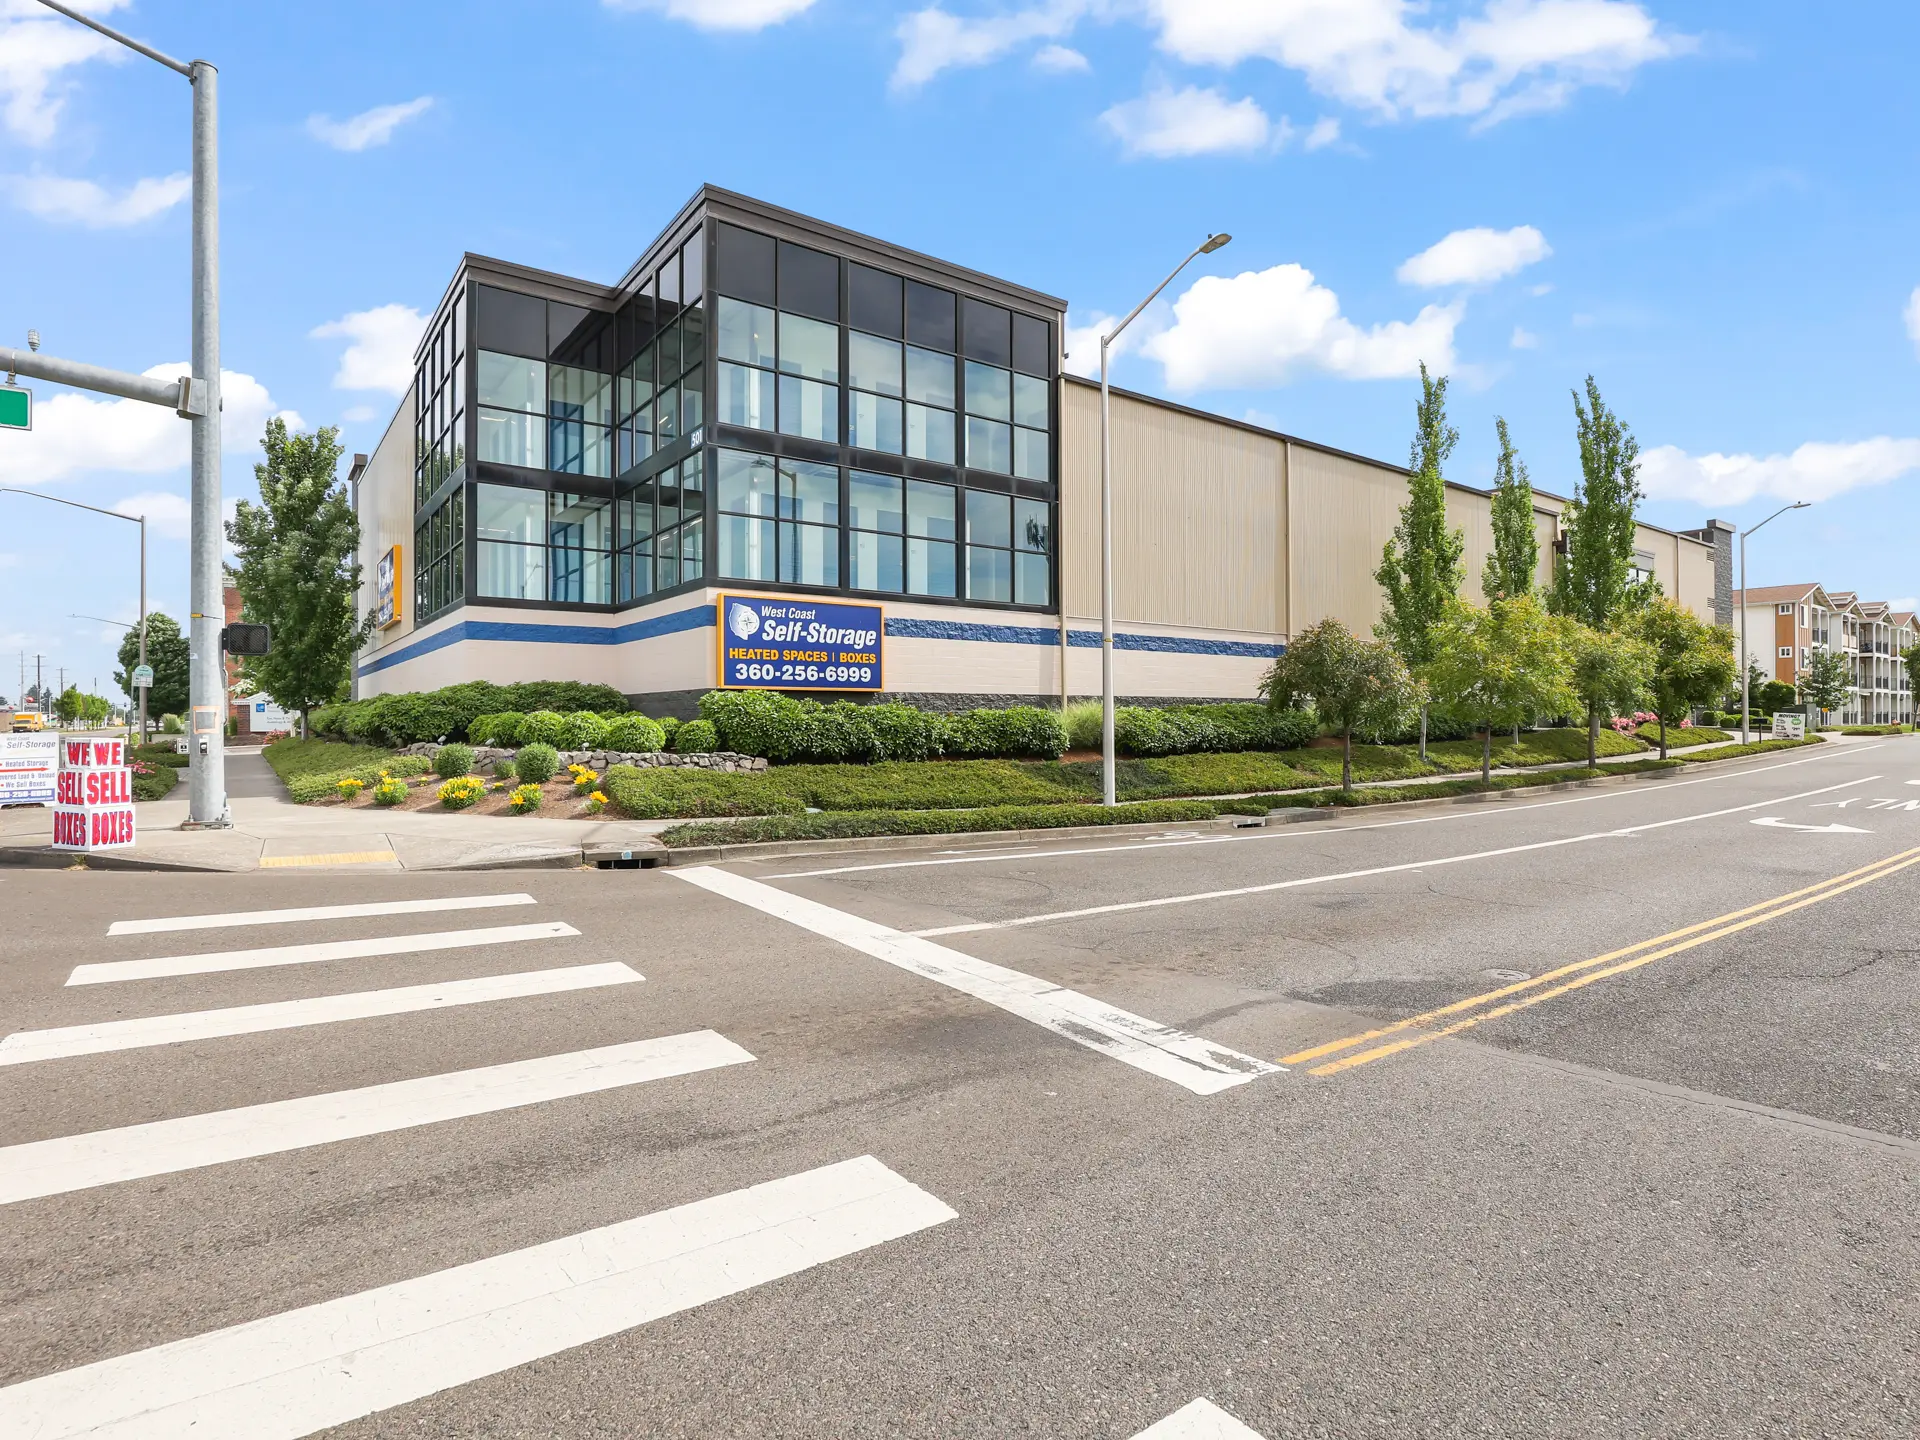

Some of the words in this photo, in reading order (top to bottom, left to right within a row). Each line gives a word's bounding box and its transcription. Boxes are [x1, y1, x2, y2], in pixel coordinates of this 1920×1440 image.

[692, 430, 702, 447] 501
[761, 605, 786, 618] West
[788, 607, 816, 620] Coast
[761, 619, 877, 650] Self-Storage
[729, 648, 779, 661] HEATED
[782, 650, 828, 662] SPACES
[839, 652, 877, 664] BOXES
[735, 663, 872, 683] 360-256-6999
[6, 741, 56, 749] Self-Storage
[67, 742, 90, 766] WE
[93, 742, 121, 766] WE
[57, 771, 84, 805] SELL
[86, 771, 130, 805] SELL
[54, 810, 86, 846] BOXES
[92, 810, 133, 846] BOXES
